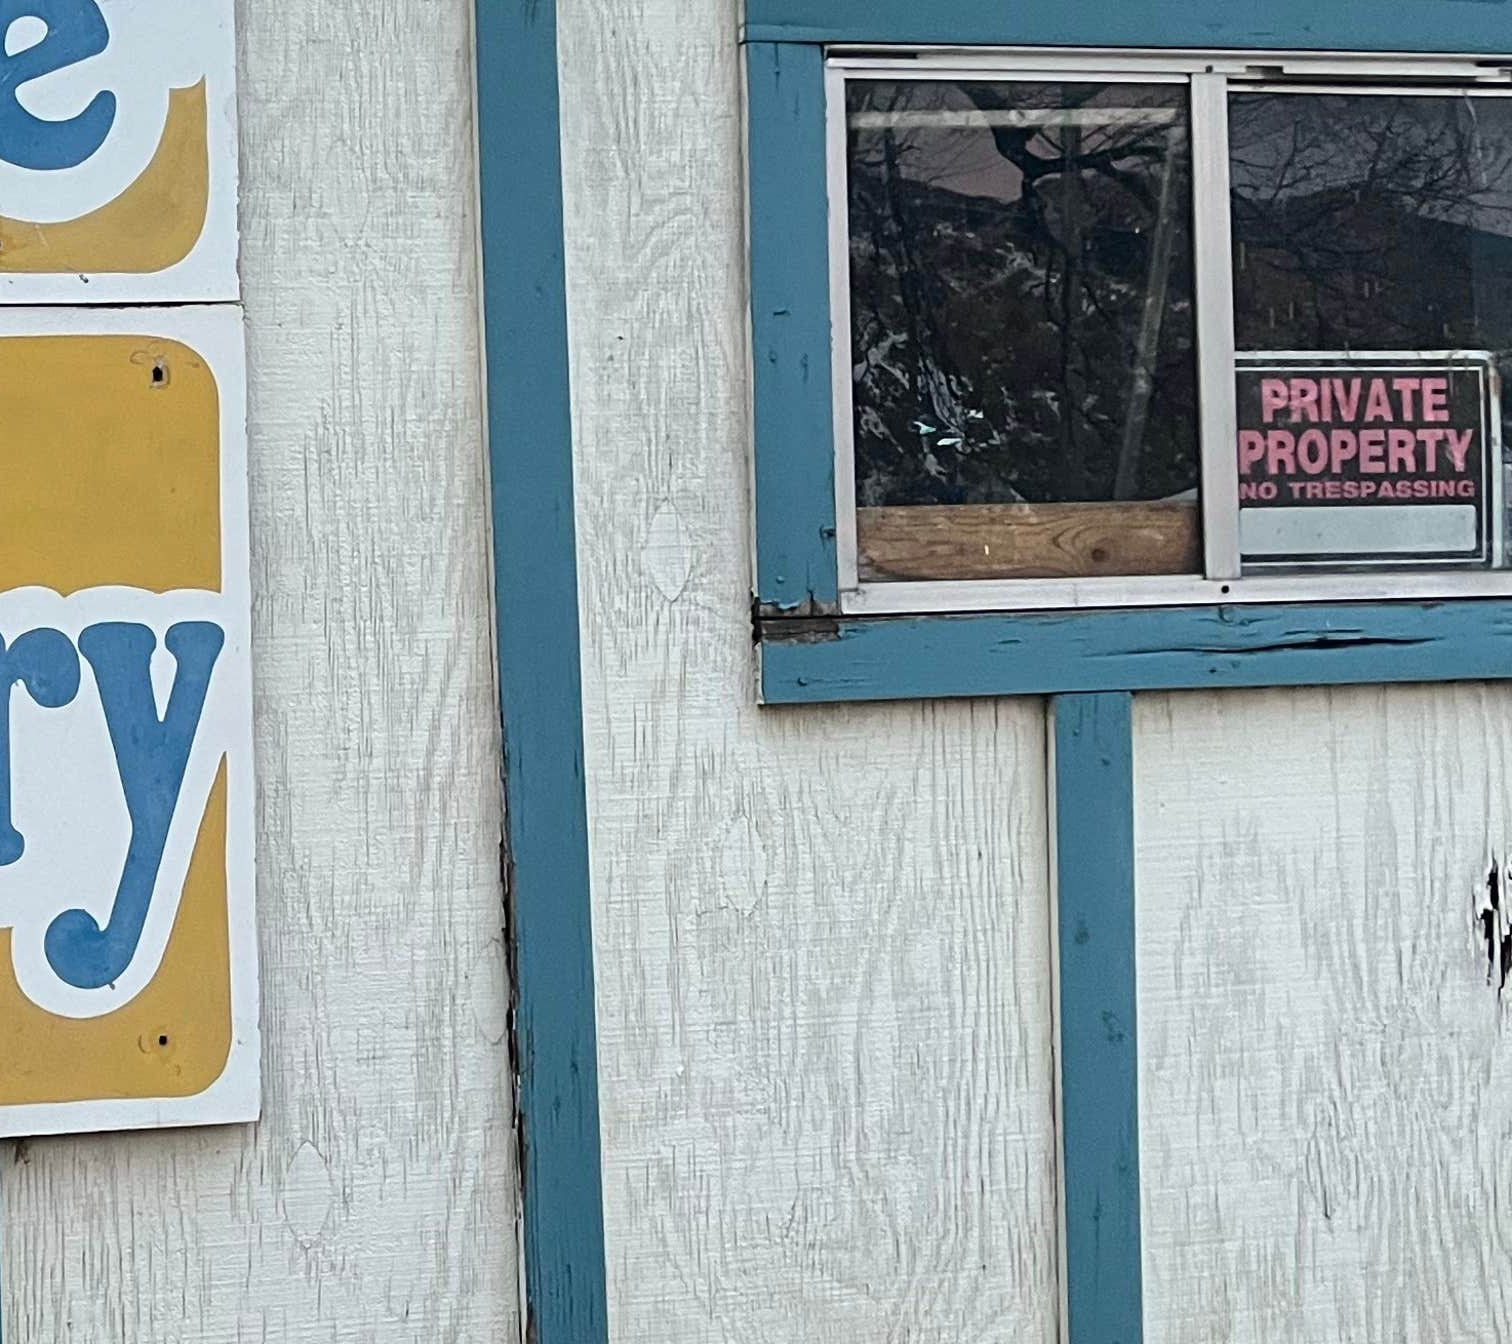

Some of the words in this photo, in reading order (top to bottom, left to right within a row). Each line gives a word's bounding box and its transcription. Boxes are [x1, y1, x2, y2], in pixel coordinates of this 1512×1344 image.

[1261, 377, 1450, 423] PRIVATE
[1239, 428, 1474, 475] PROPERTY
[1239, 482, 1278, 500] NO
[1289, 480, 1475, 500] TRESPASSING
